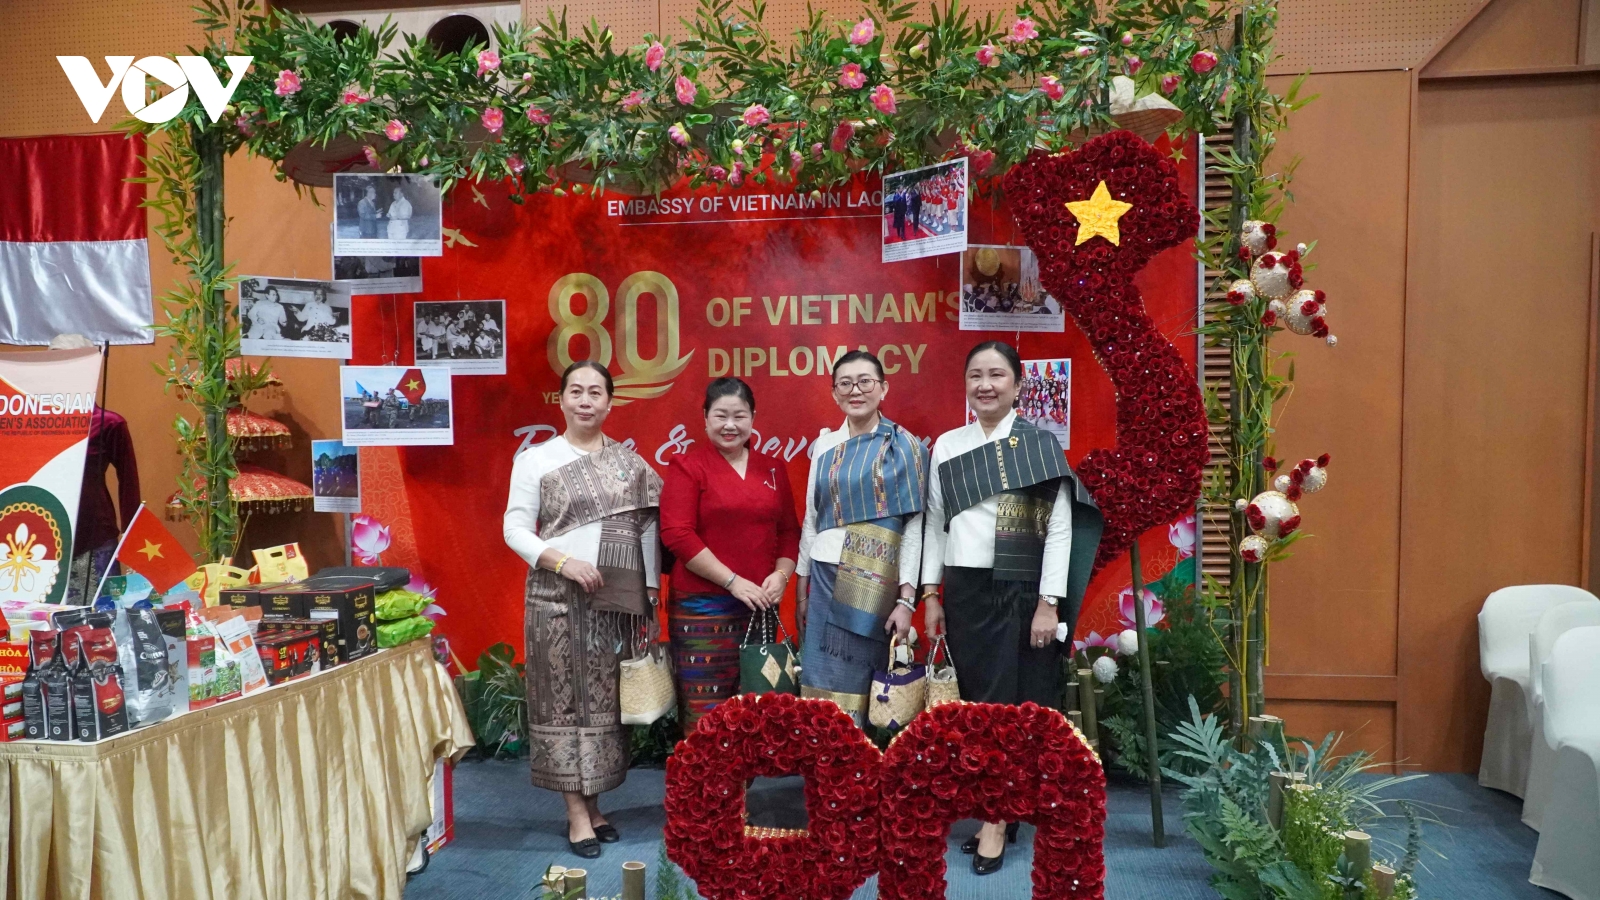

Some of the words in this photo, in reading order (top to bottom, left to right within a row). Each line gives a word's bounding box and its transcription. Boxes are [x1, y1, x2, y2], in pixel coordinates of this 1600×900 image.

[607, 197, 694, 217] EMBASSY
[700, 196, 723, 213] OF
[728, 192, 815, 212] VIETNAM
[822, 192, 841, 208] IN
[706, 297, 752, 328] OF
[762, 290, 960, 326] VIETNAM'S
[547, 270, 694, 390] 80
[708, 343, 927, 378] DIPLOMCY
